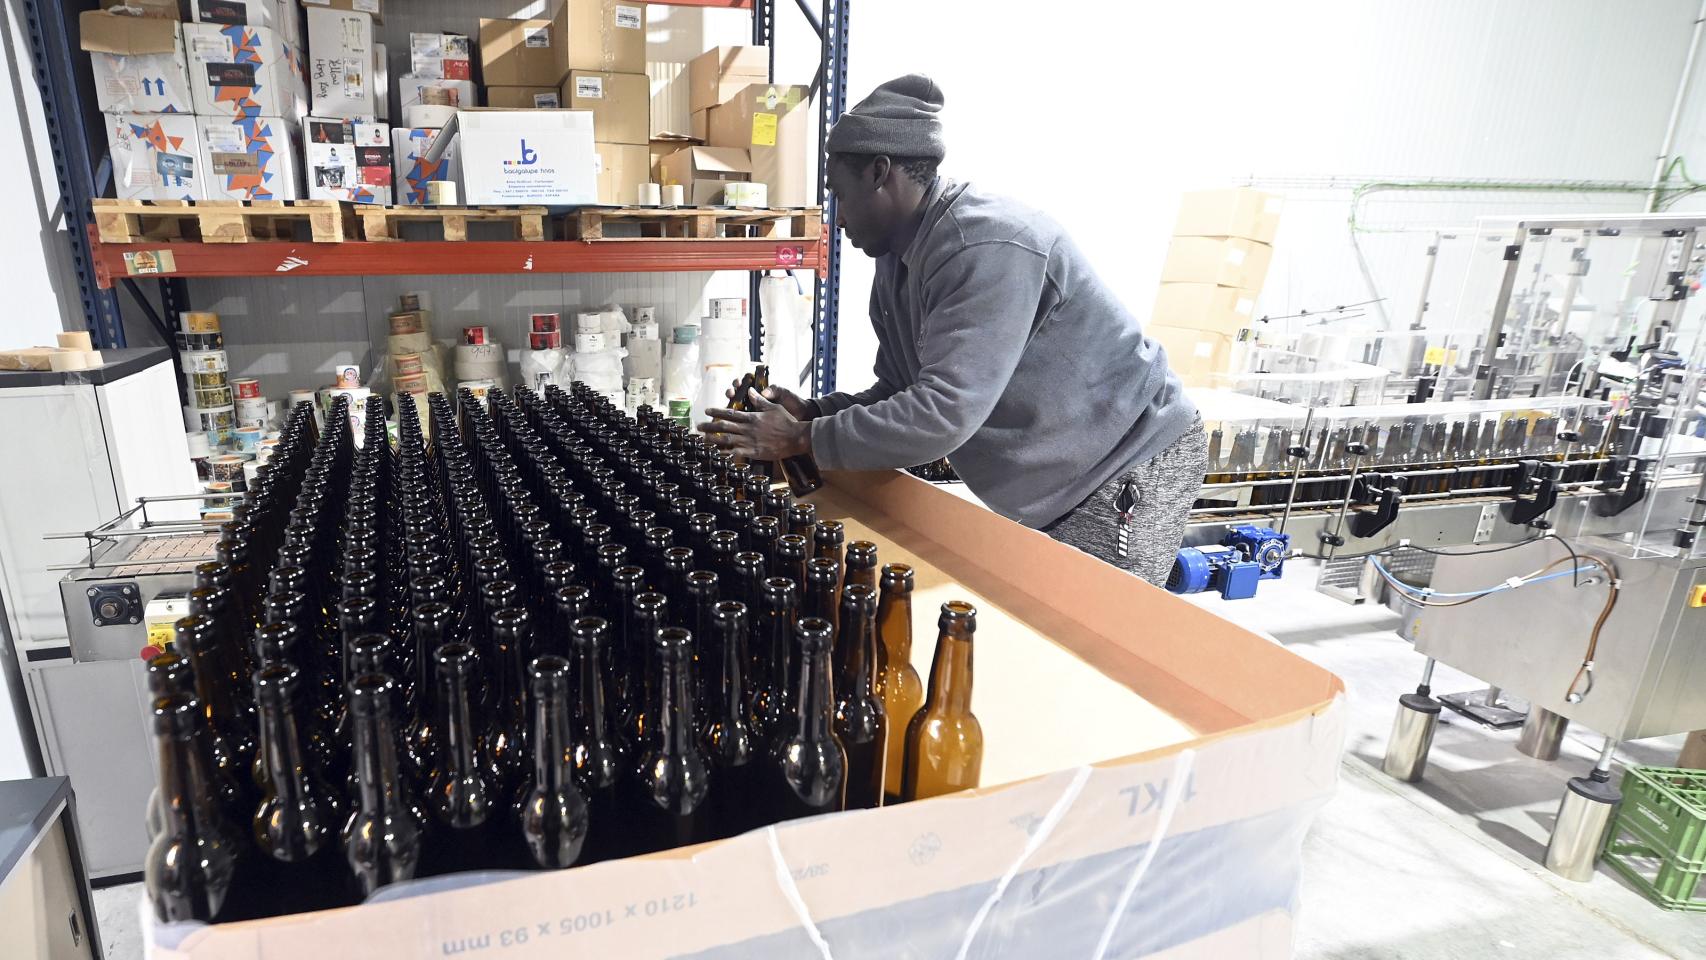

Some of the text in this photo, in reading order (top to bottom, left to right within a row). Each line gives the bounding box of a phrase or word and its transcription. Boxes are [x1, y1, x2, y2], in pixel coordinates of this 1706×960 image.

[1119, 777, 1169, 816] KL
[442, 891, 699, 956] 1210 x 1005 x 93 mm
